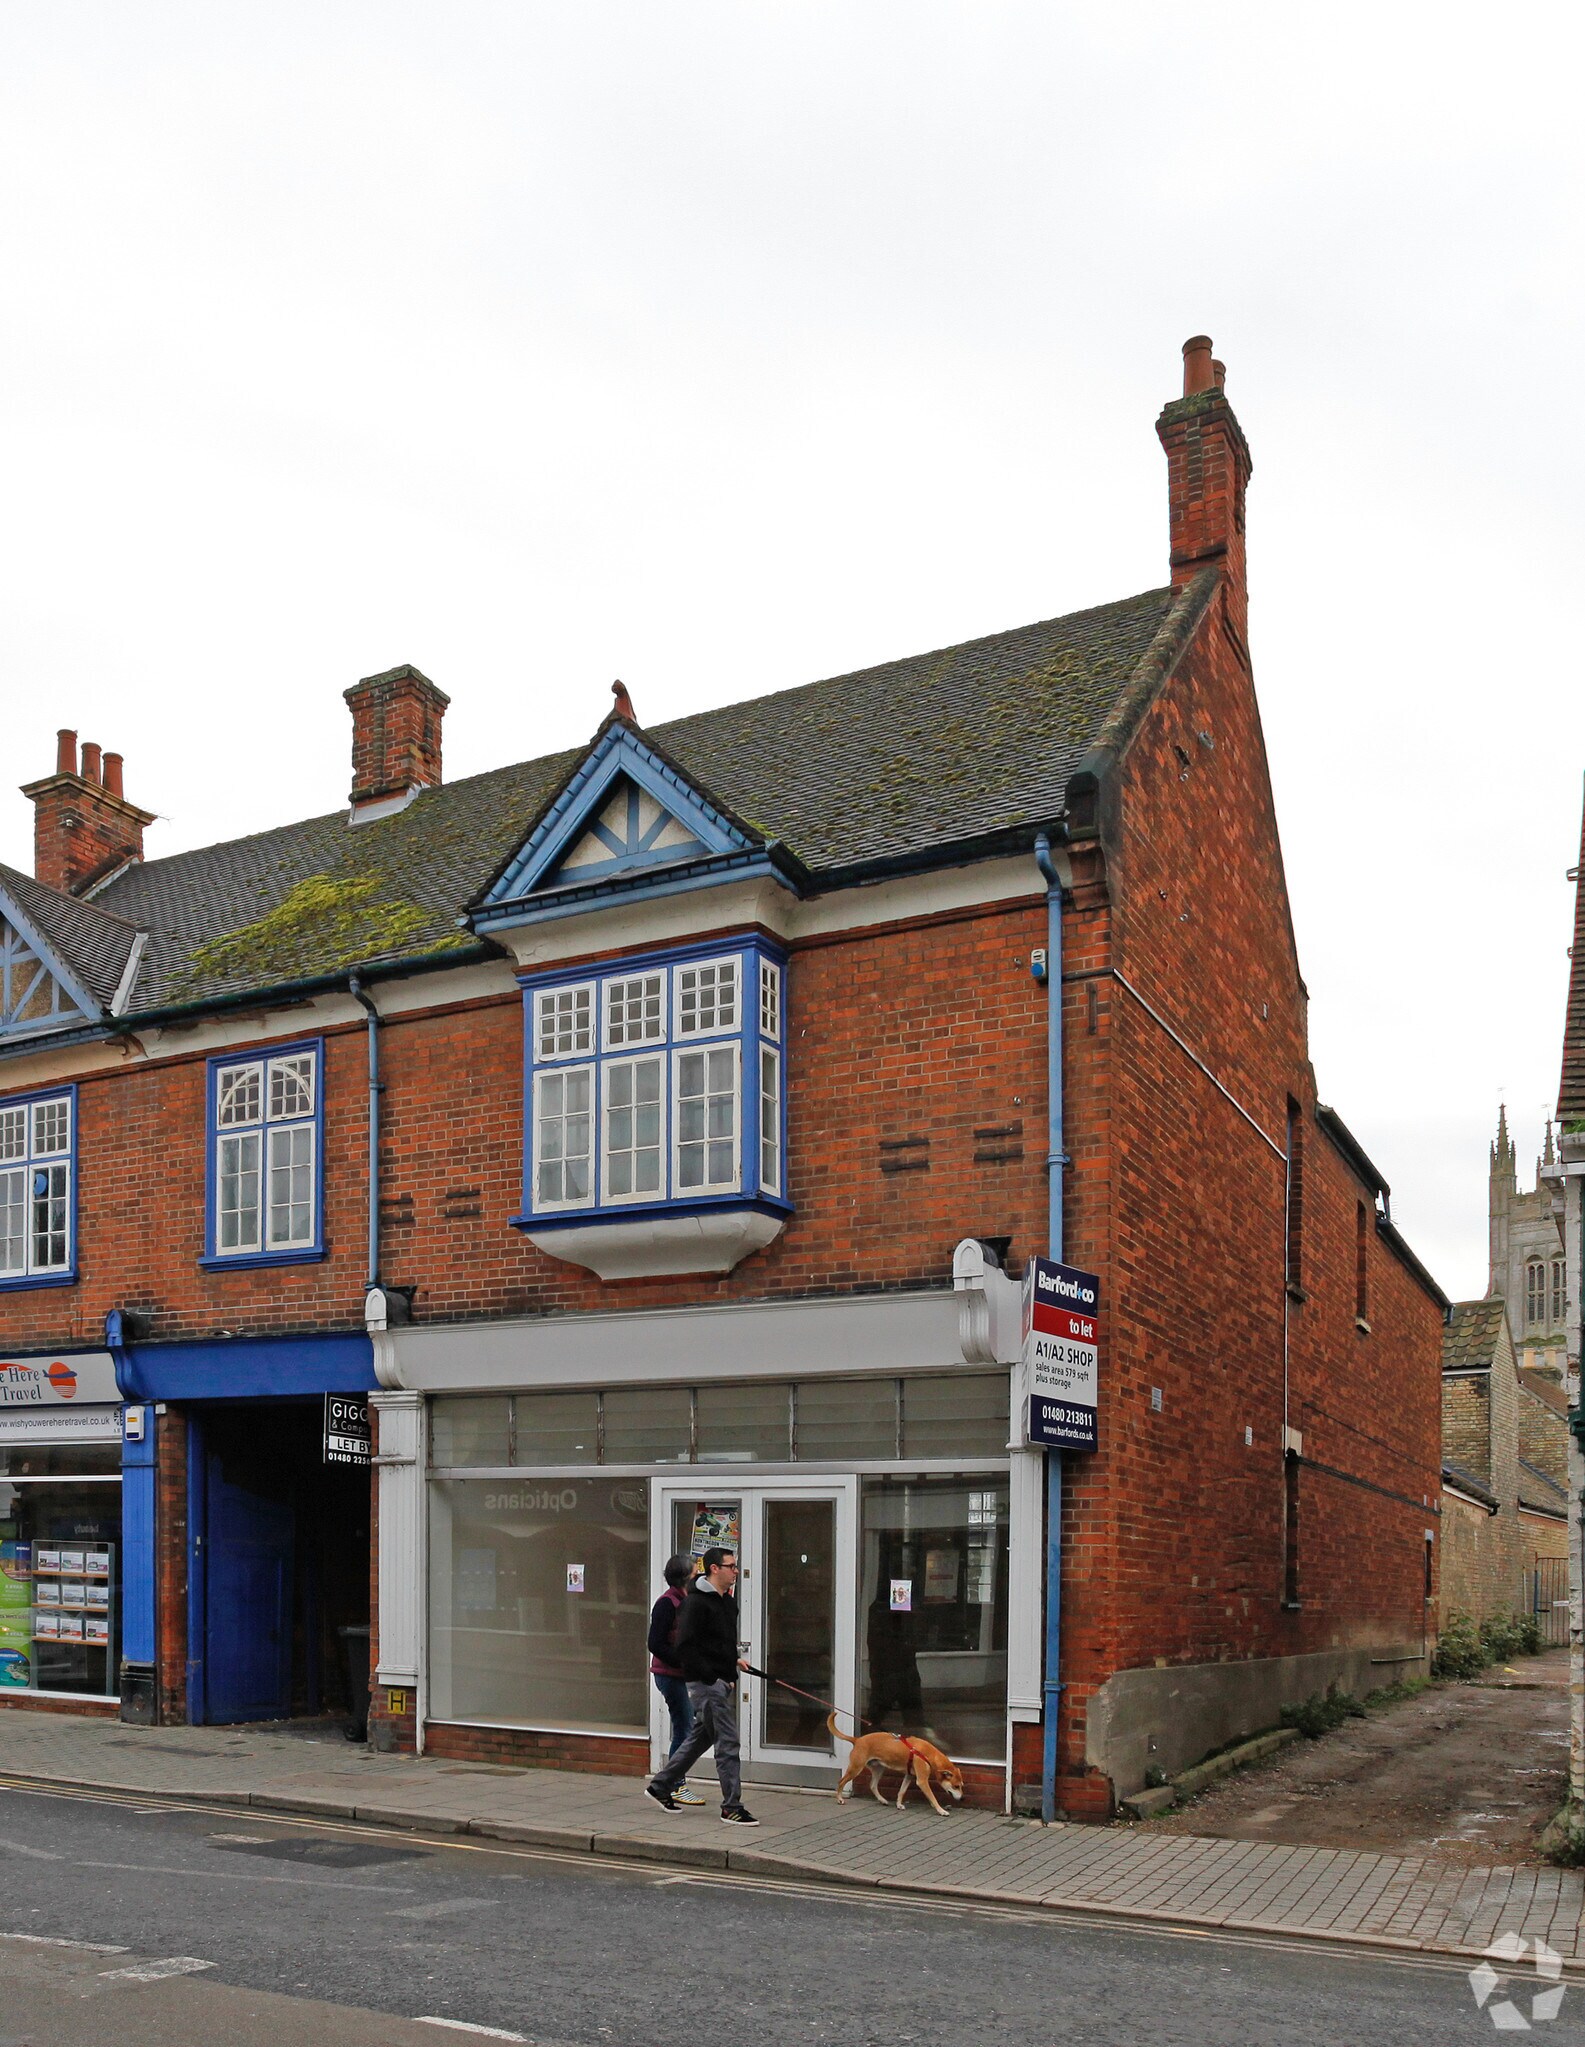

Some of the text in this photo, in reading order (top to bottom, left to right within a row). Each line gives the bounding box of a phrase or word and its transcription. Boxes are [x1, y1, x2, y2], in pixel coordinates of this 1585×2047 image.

[1038, 1270, 1095, 1304] Barford+co
[1069, 1318, 1093, 1338] to let
[1035, 1341, 1094, 1367] A1/A2 SHOP
[8, 1367, 40, 1383] Here
[1035, 1362, 1089, 1383] sales area 579 sqft
[1035, 1373, 1072, 1390] plus storage
[1, 1384, 42, 1401] Travel
[331, 1419, 338, 1429] &
[1042, 1405, 1093, 1427] 01480 213811
[1042, 1425, 1094, 1441] www.barfords.co.uk
[337, 1438, 356, 1451] LET
[328, 1452, 352, 1463] 01480
[390, 1691, 404, 1712] H
